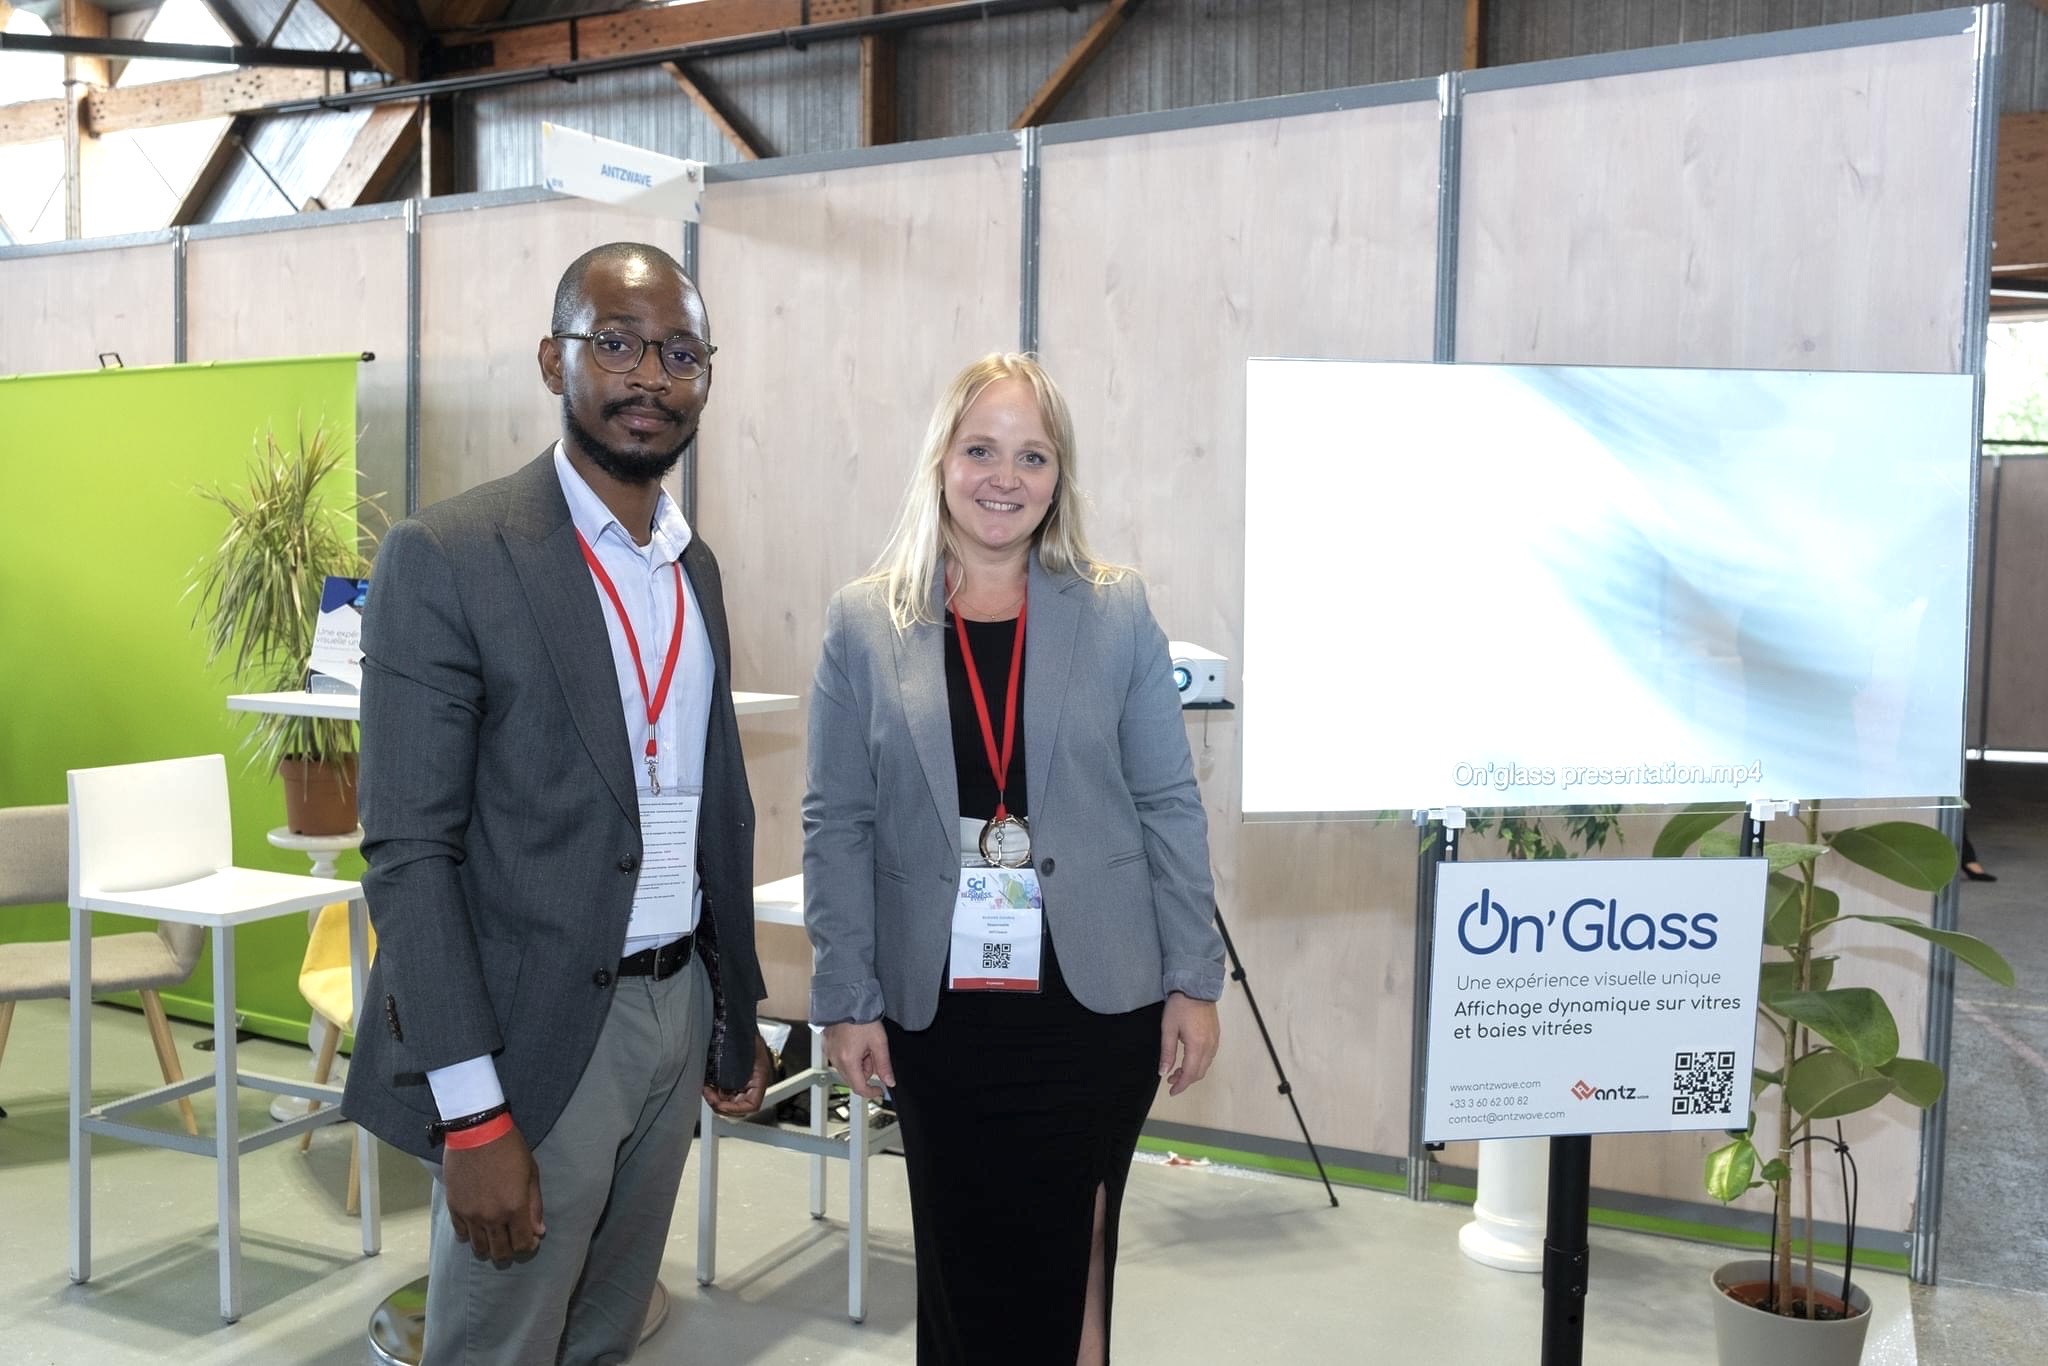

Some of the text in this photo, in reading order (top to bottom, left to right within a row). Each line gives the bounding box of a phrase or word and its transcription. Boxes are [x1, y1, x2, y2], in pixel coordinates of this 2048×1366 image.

[600, 164, 652, 187] ANTZWAVE
[1452, 760, 1763, 790] On'glass presentation.mp4
[1458, 888, 1718, 955] On'Glass
[1457, 970, 1721, 992] Une expérience visuelle unique
[1454, 995, 1741, 1019] Affichage dynamique sur vitres
[1453, 1019, 1593, 1039] et baies vitrées
[1450, 1080, 1541, 1092] www.antzwave.com
[1594, 1085, 1636, 1101] antz
[1449, 1098, 1466, 1109] +33
[1468, 1098, 1474, 1108] 3
[1476, 1097, 1488, 1108] 60
[1490, 1096, 1502, 1107] 62
[1503, 1096, 1515, 1106] 00
[1448, 1111, 1566, 1125] contact@antzwave.com
